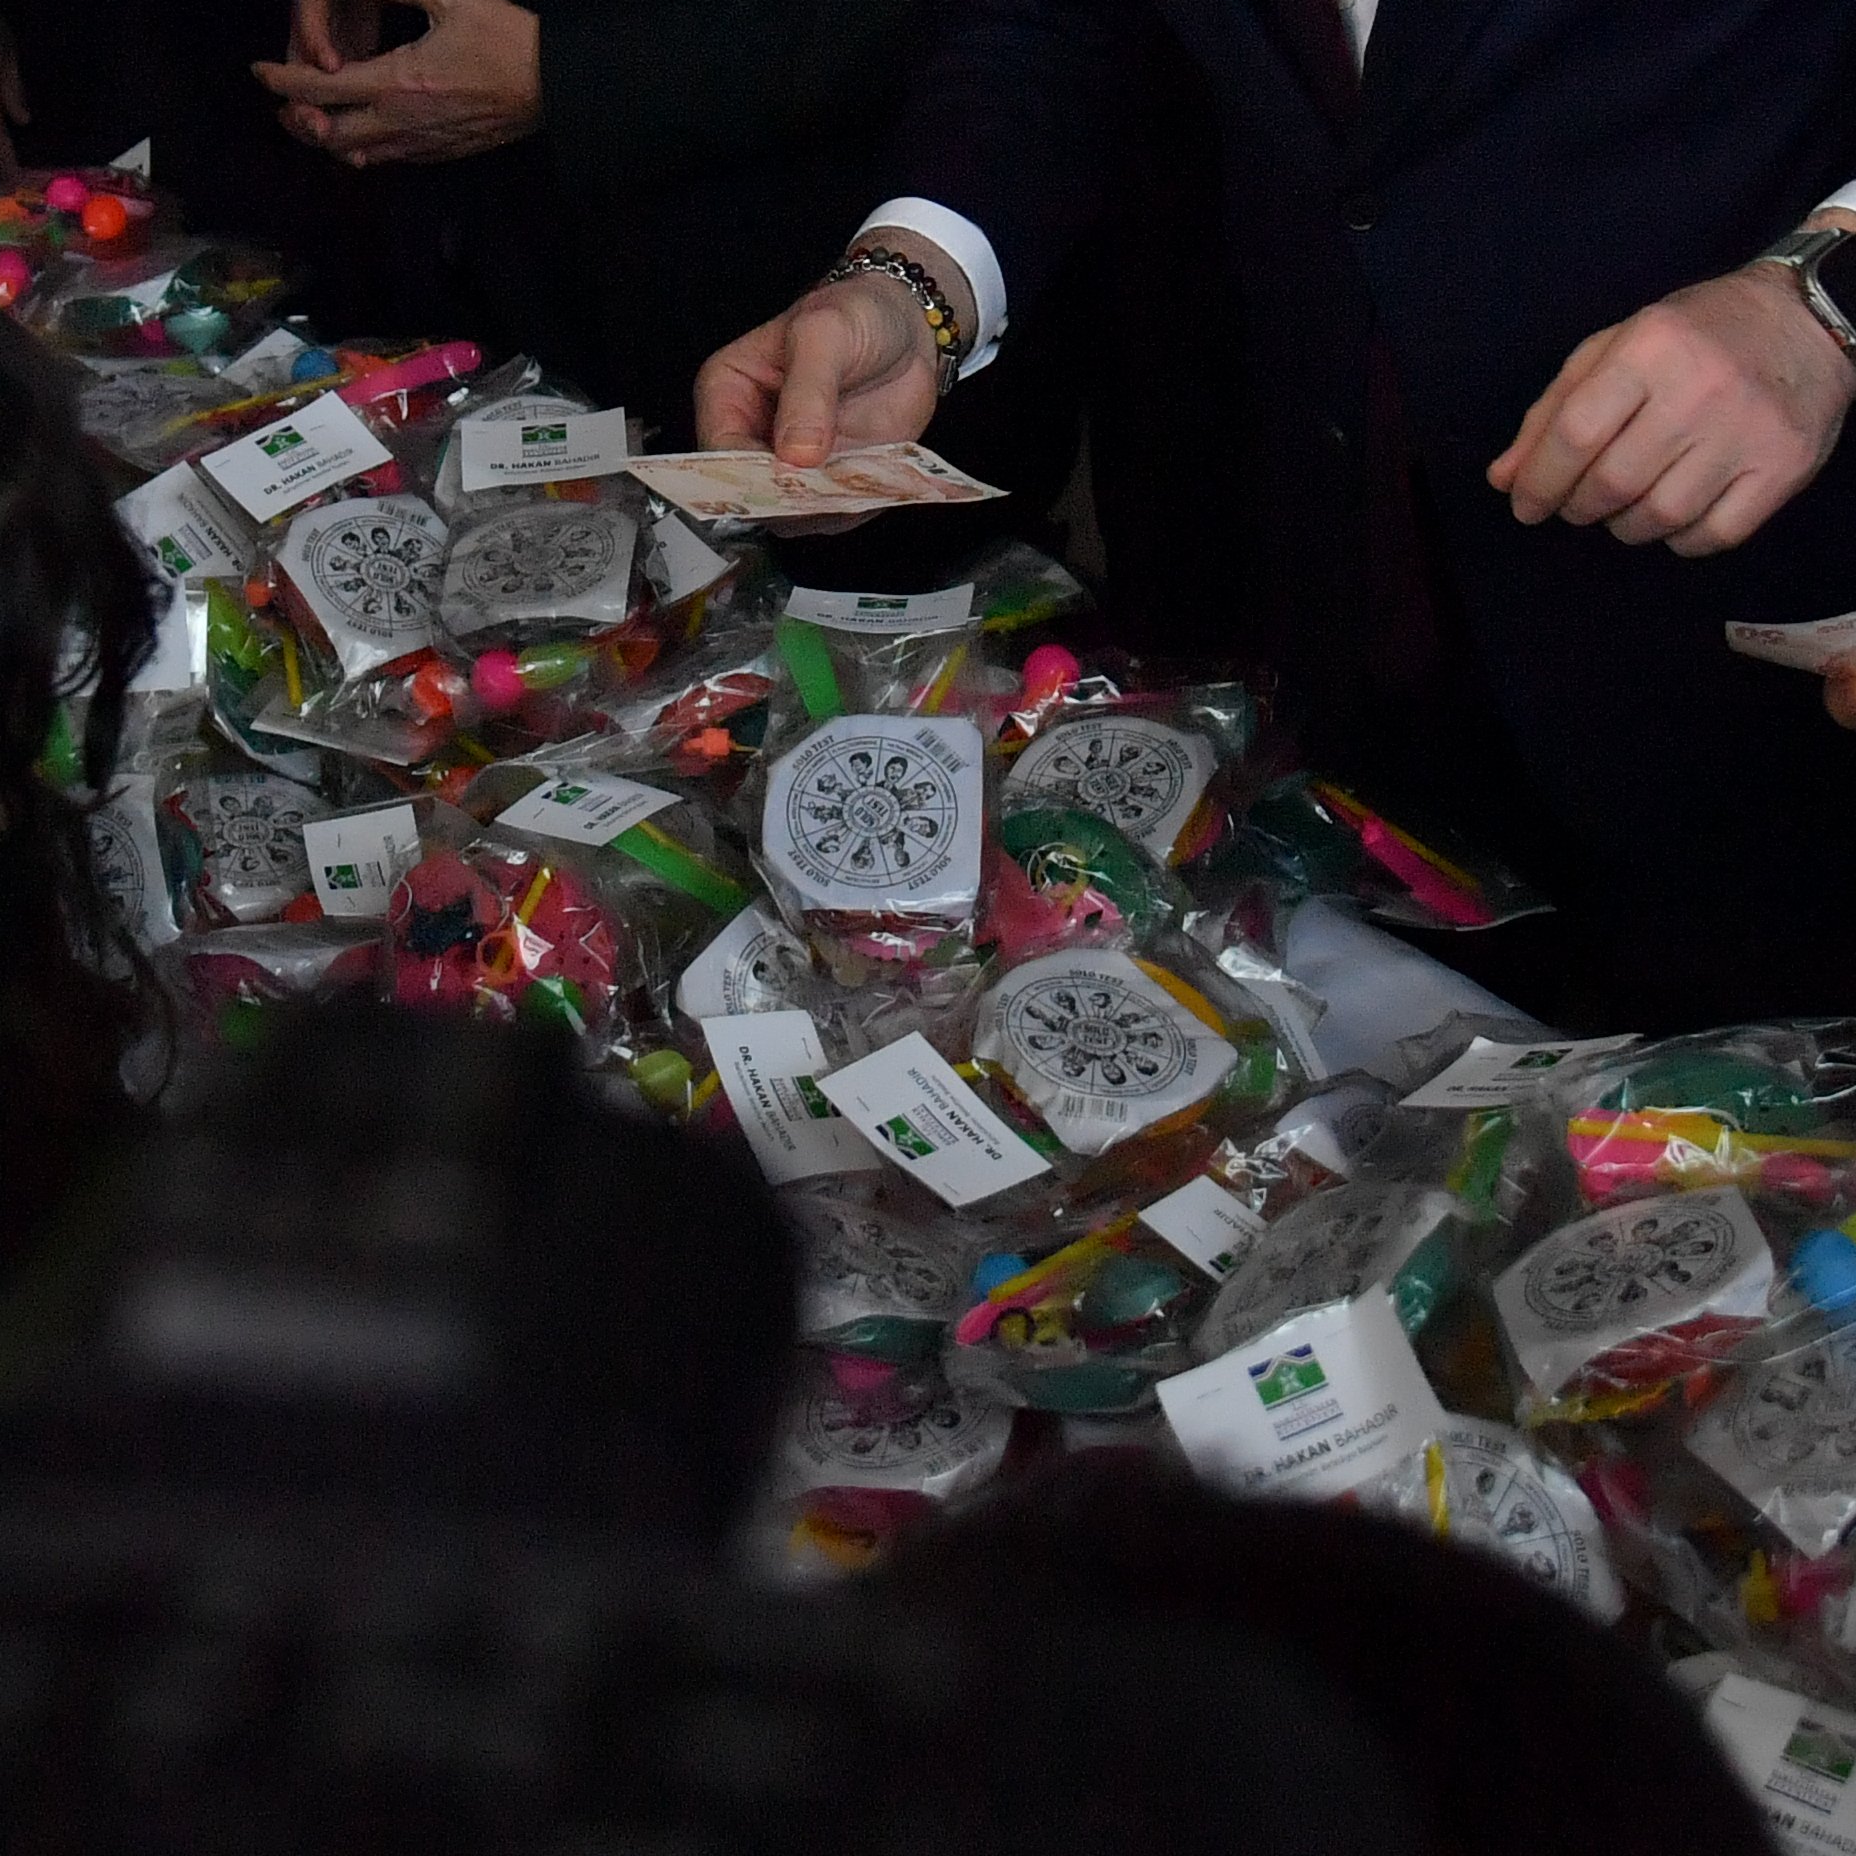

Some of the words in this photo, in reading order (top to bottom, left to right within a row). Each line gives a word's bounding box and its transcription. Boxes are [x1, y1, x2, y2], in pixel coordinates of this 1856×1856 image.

[512, 460, 552, 469] HAKAN
[554, 453, 601, 466] BAHADIR
[263, 482, 282, 495] DR.
[282, 464, 316, 486] HAKAN
[204, 525, 233, 558] HAKAN
[1080, 723, 1103, 732] TEST
[792, 749, 814, 771] SOLO
[812, 735, 835, 754] TEST
[854, 806, 877, 827] SOLO
[867, 797, 890, 818] TEST
[787, 849, 809, 871] TEST
[929, 855, 952, 879] SOLO
[807, 868, 832, 887] SOLO
[908, 873, 932, 891] TEST
[723, 968, 734, 991] TEST
[1069, 968, 1097, 978] SOLO
[1099, 973, 1125, 986] TEST
[1083, 1024, 1110, 1036] SOLO
[738, 1045, 752, 1066] DR.
[747, 1067, 772, 1109] HAKAN
[907, 1067, 950, 1111] BAHADIR
[946, 1110, 985, 1145] HAKAN
[984, 1144, 1004, 1161] DR.
[1273, 1439, 1332, 1472] HAKAN
[1333, 1403, 1399, 1448] BAHADIR
[1572, 1529, 1589, 1564] SOLO
